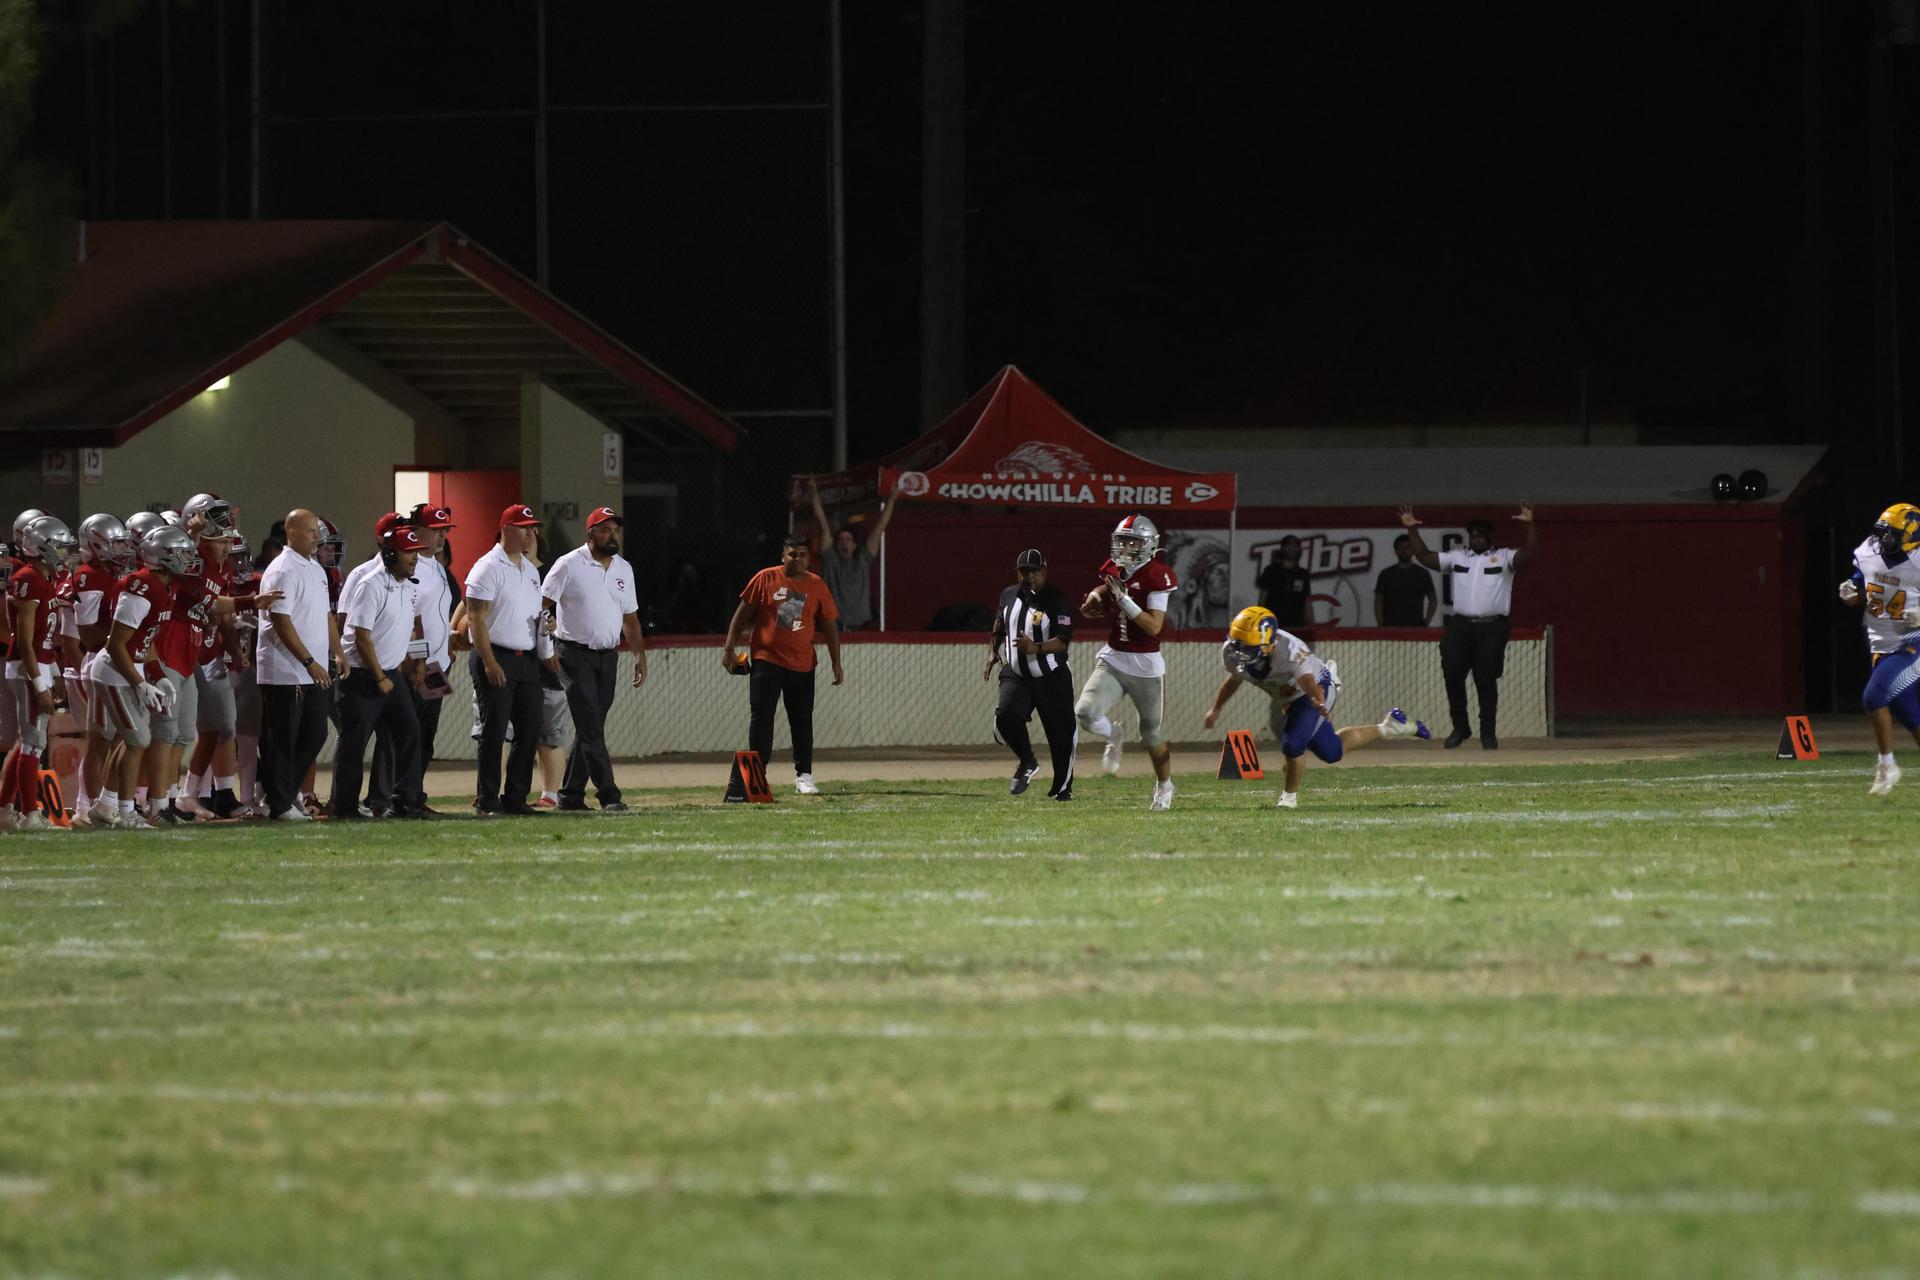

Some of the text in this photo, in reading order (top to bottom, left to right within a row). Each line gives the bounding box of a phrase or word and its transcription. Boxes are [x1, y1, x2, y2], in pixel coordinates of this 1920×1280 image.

[938, 482, 1173, 505] CHOWCHILLA TRIBE
[1250, 534, 1373, 580] Tibe
[1163, 572, 1172, 587] 1
[1234, 734, 1260, 772] 10
[1796, 719, 1814, 753] G
[742, 754, 769, 796] 20
